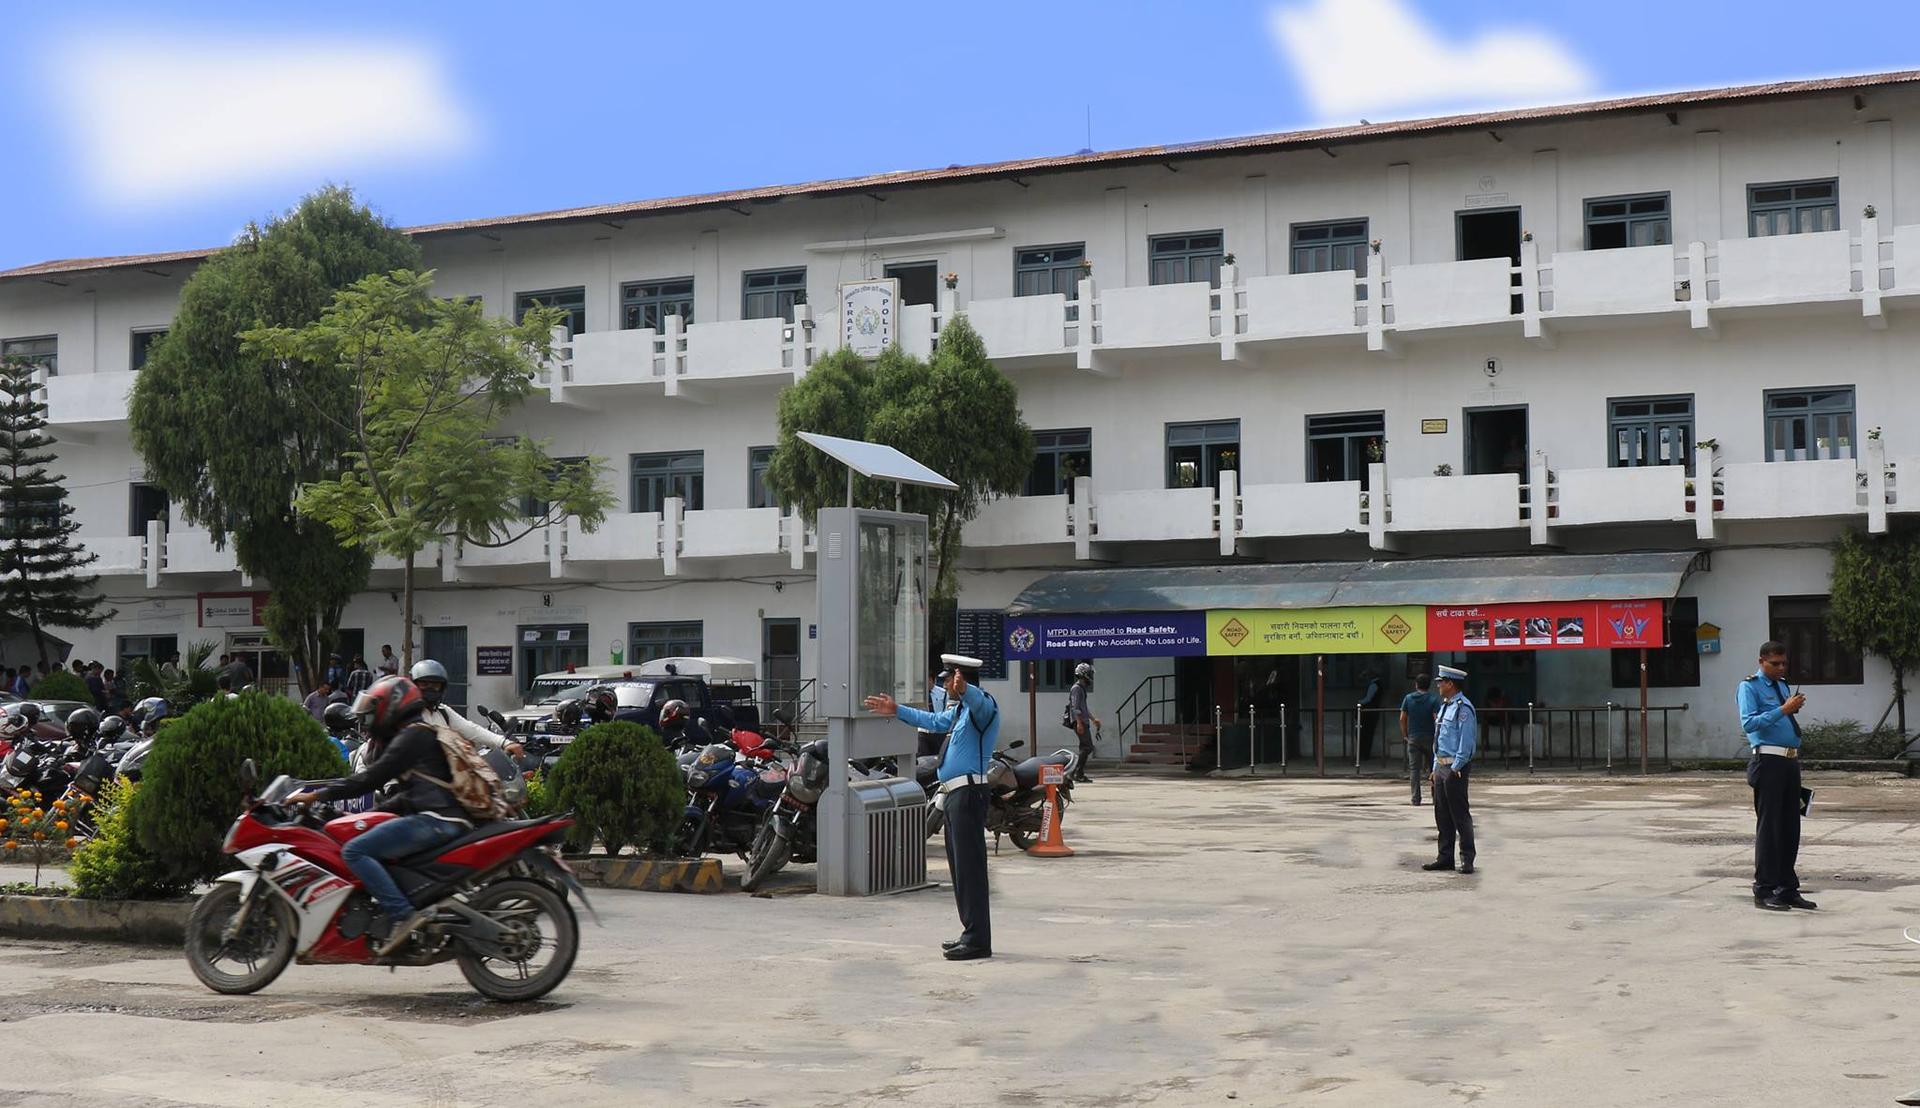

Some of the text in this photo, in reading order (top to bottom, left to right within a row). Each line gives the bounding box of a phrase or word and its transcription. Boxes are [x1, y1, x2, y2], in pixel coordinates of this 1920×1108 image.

[1047, 629, 1068, 637] MTPD
[1079, 628, 1115, 636] committed
[1126, 627, 1147, 635] Road
[1046, 640, 1067, 648] Road
[1068, 640, 1096, 648] Safety:
[1146, 637, 1157, 645] No
[1158, 637, 1176, 645] Loss
[1177, 636, 1185, 644] of
[1187, 635, 1202, 644] Life.
